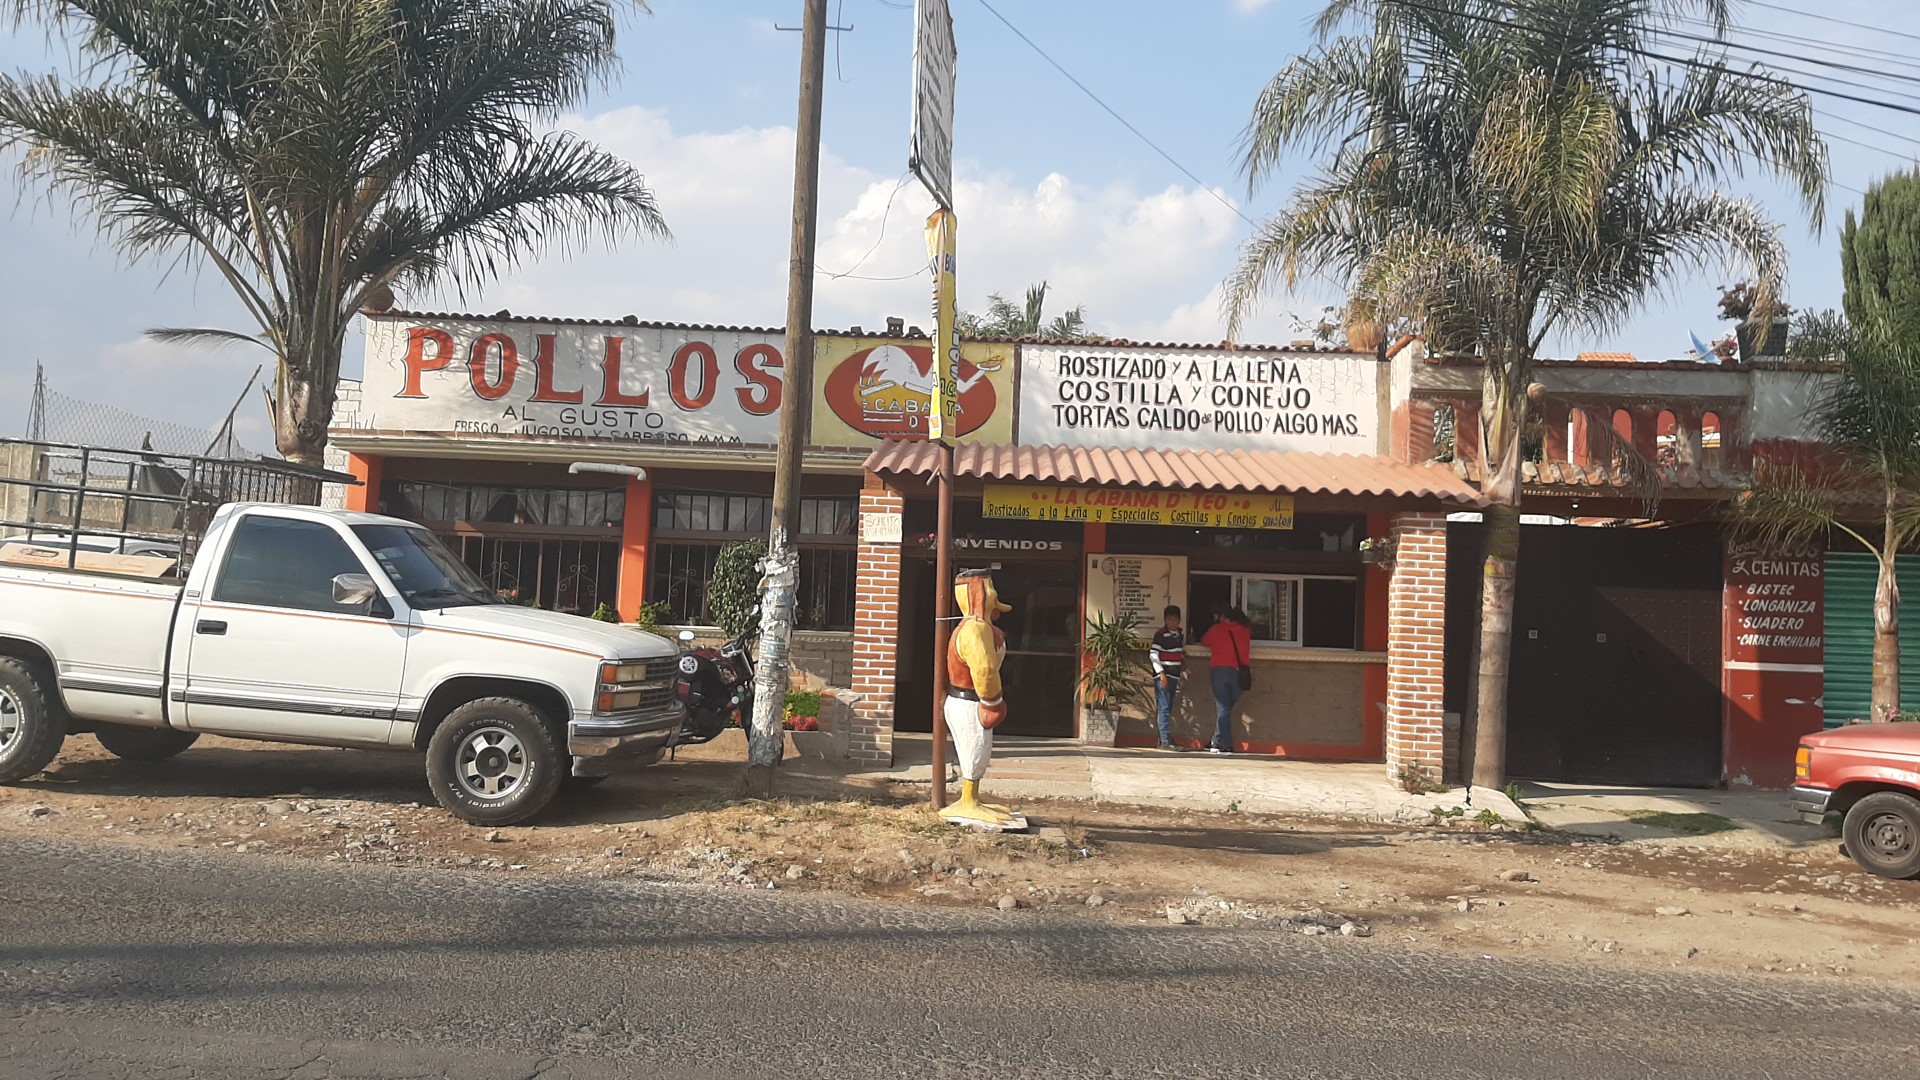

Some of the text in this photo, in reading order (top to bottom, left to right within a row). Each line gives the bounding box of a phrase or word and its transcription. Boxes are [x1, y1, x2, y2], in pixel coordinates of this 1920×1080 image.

[393, 327, 784, 416] POLLOS
[1058, 355, 1166, 379] ROSTIZADO
[1185, 360, 1202, 381] A
[1212, 360, 1237, 382] LA
[1246, 357, 1302, 384] LEÑA
[1058, 380, 1183, 406] COSTILLA
[1211, 385, 1311, 410] CONEJO
[502, 405, 664, 428] AL GUSTO
[1051, 404, 1130, 429] TORTAS
[1137, 407, 1201, 432] CALDO
[1201, 412, 1213, 425] de
[1214, 410, 1263, 433] POLLO
[1272, 412, 1318, 435] ALGO
[1054, 487, 1078, 506] LA
[1192, 492, 1228, 510] TEO
[1039, 508, 1045, 518] a
[1064, 505, 1088, 519] Leña
[1170, 510, 1209, 524] Costillas
[1227, 511, 1257, 527] Conejos
[1751, 559, 1820, 577] CEMITAS
[1746, 584, 1795, 595] BISTEC
[1743, 599, 1816, 613] LONGANIZA
[1742, 617, 1804, 630] SUADERO
[1739, 635, 1821, 648] CARNE ENCHILADA
[467, 800, 505, 809] Radial
